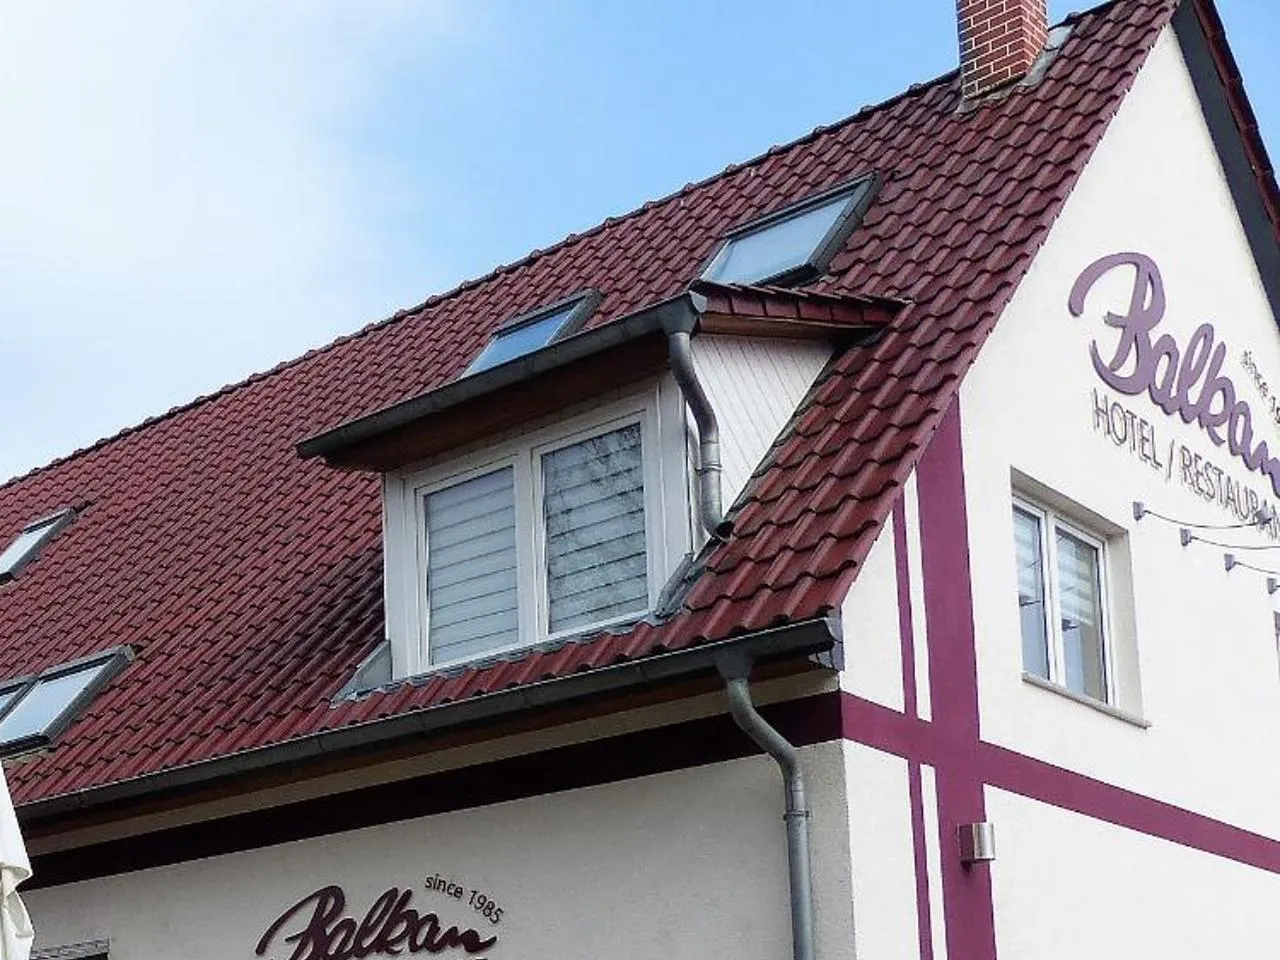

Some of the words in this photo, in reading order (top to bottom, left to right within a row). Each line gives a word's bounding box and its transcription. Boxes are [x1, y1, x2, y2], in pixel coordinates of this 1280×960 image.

[1091, 388, 1163, 471] HOTEL
[424, 873, 464, 899] since
[467, 889, 505, 925] 1985
